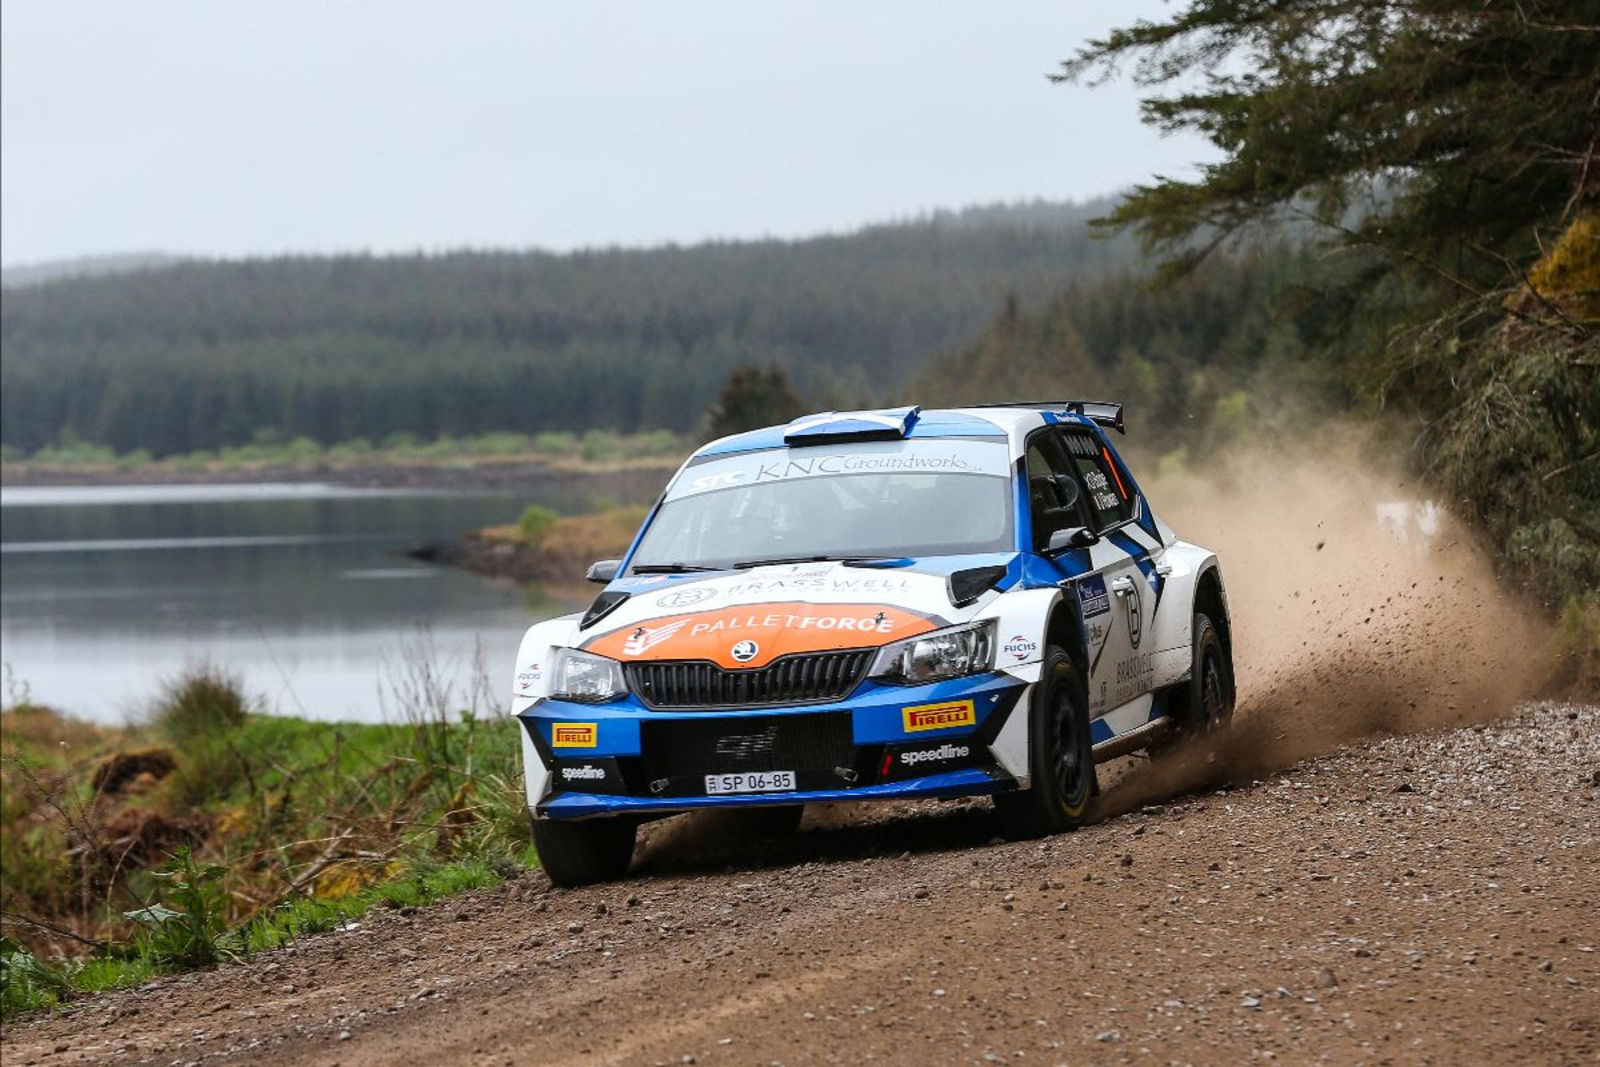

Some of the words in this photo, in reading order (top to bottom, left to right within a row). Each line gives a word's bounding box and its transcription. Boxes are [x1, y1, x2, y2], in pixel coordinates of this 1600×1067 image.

[756, 456, 845, 481] KNC
[844, 453, 969, 470] Groundworks
[1004, 642, 1037, 653] FUCHS
[909, 705, 969, 727] PIRELLI
[556, 727, 592, 743] PIRELLI
[900, 744, 969, 766] speedline
[561, 764, 605, 780] speedline
[722, 776, 744, 791] SP
[748, 774, 791, 789] 06-85
